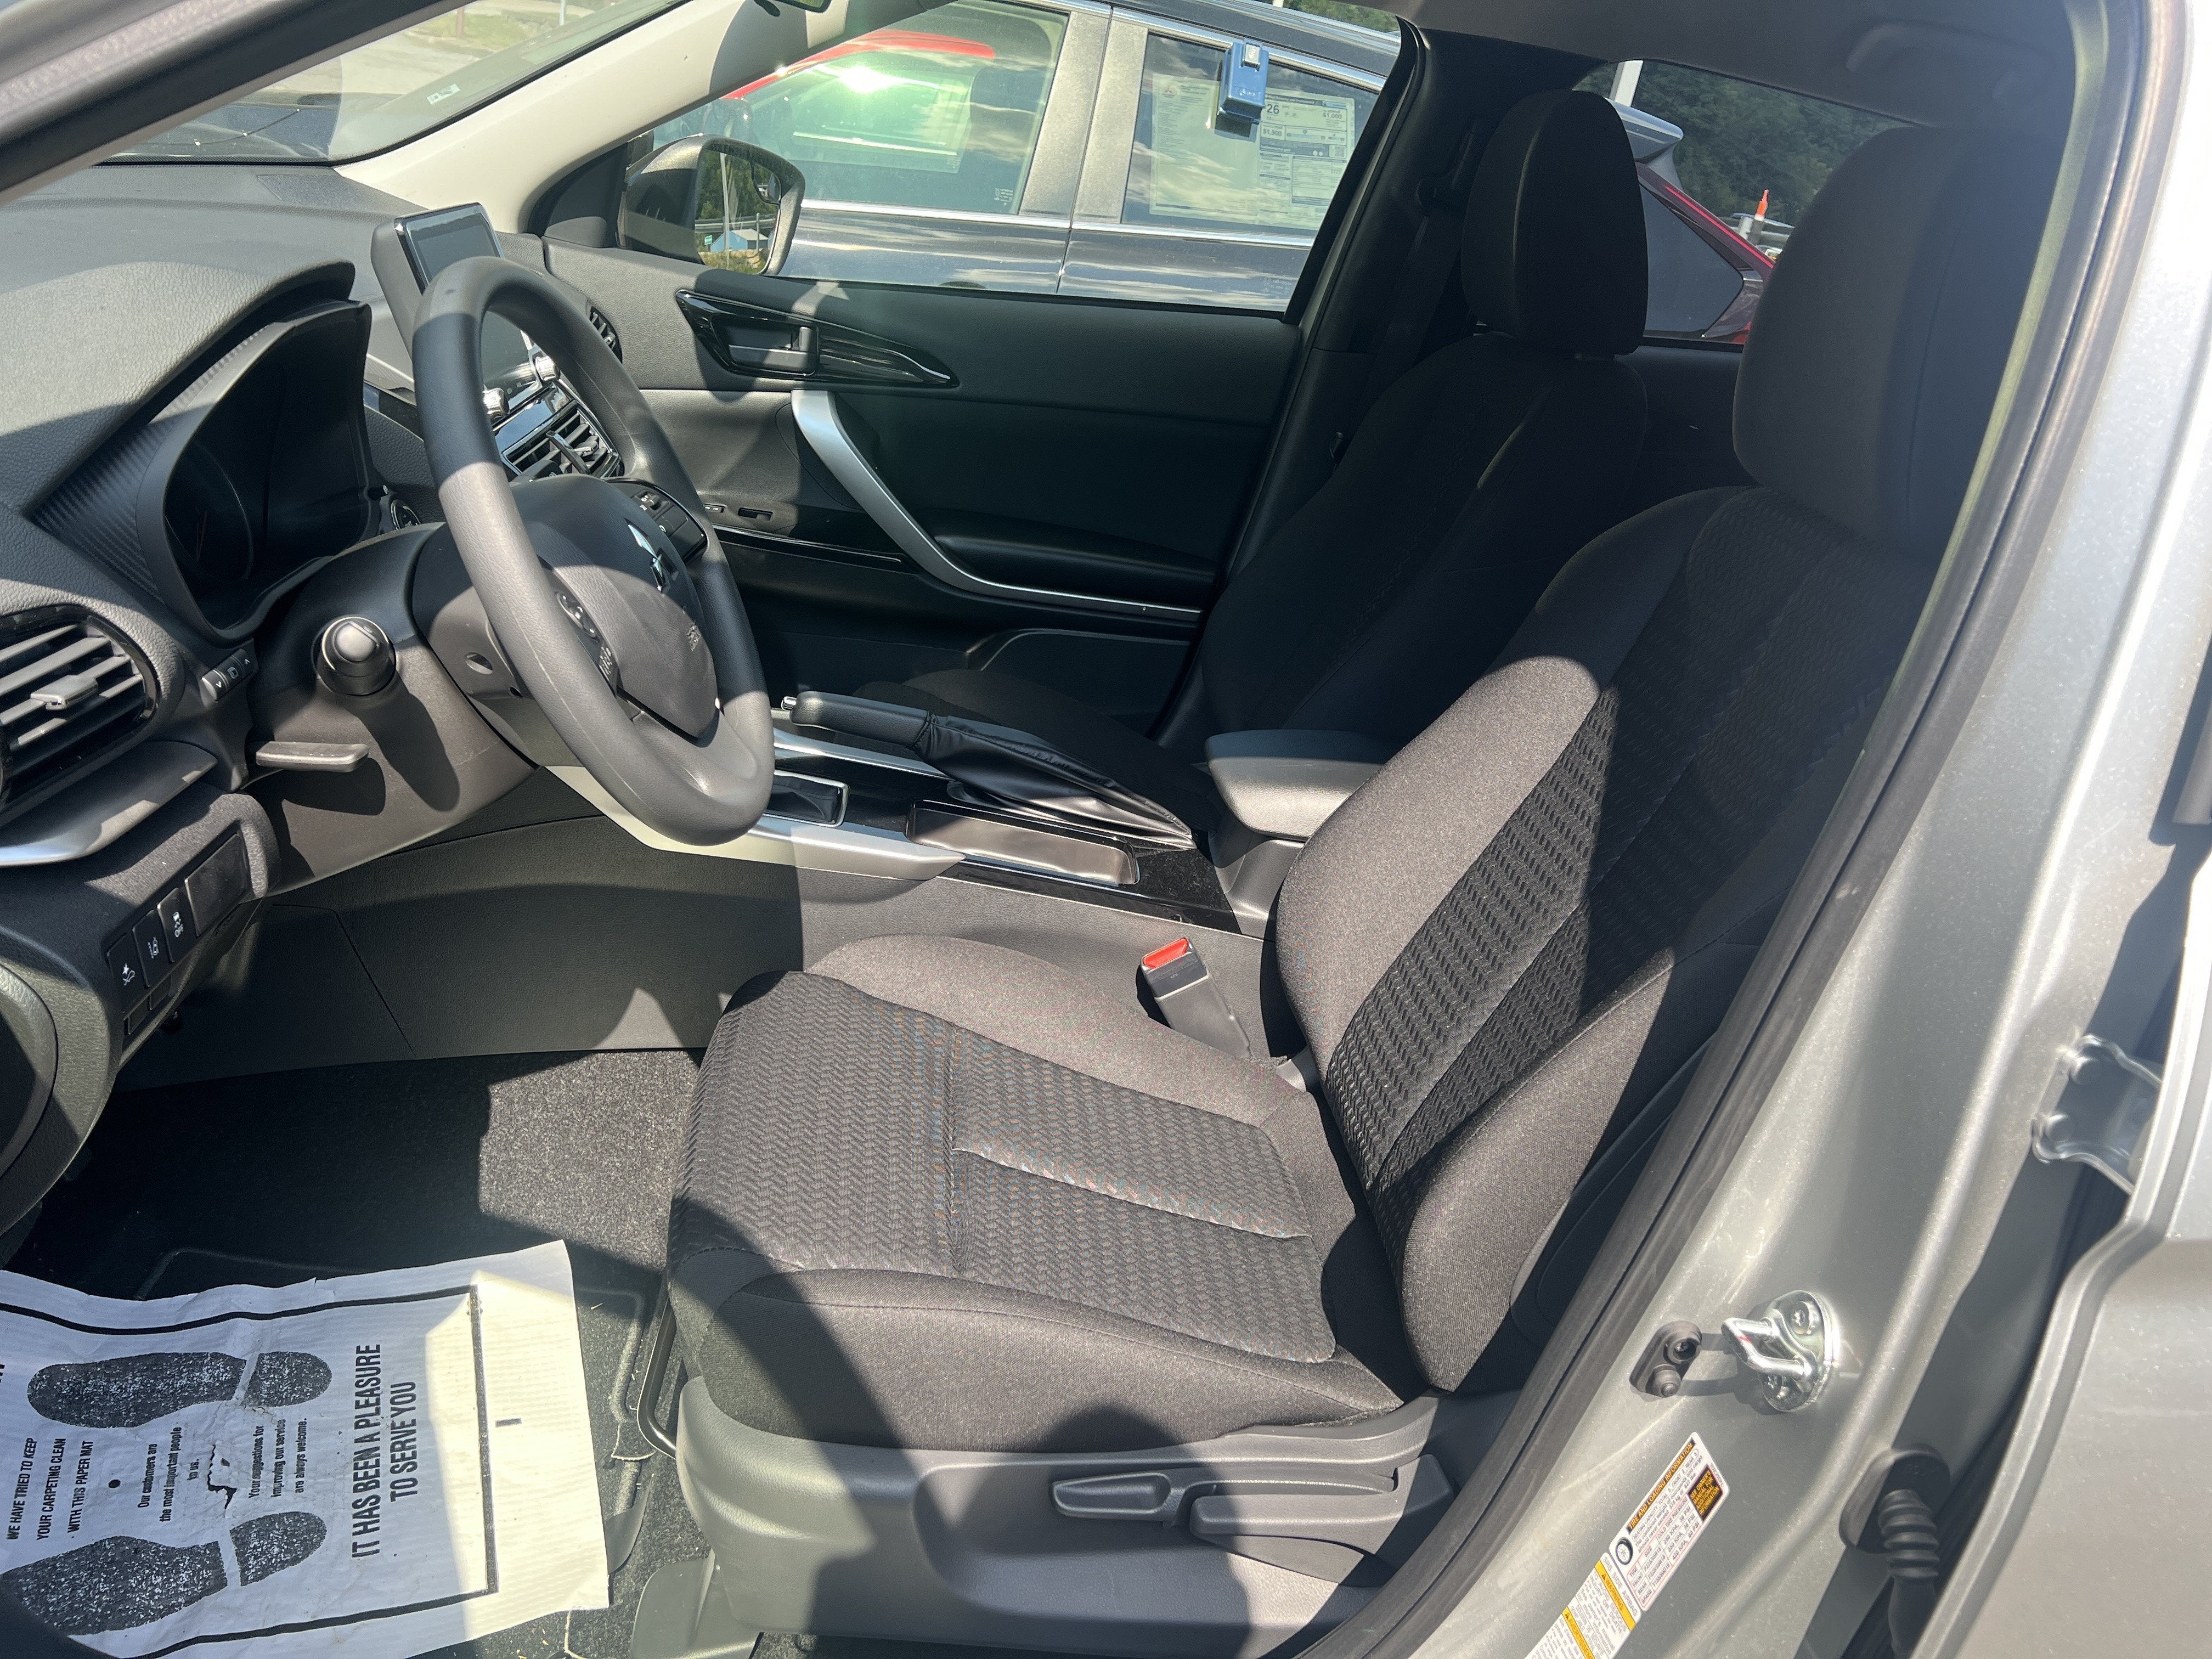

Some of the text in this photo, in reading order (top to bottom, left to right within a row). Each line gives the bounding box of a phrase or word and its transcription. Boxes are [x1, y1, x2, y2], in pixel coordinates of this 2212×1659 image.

[1267, 104, 1279, 115] 26
[253, 1425, 264, 1437] for
[389, 1381, 418, 1502] TO SERVE YOU
[187, 1459, 199, 1481] to us.
[275, 1447, 284, 1459] our
[294, 1418, 307, 1493] are always welcome.
[352, 1344, 381, 1558] IT HAS BEEN A PLEASURE
[6, 1438, 37, 1539] WE HAVE TRIED TO KEEP
[36, 1438, 66, 1541] YOUR CARPETING CLEAN
[67, 1440, 93, 1533] WITH THIS PAPER MAT
[142, 1455, 156, 1493] customers
[159, 1426, 182, 1522] the most important people
[248, 1480, 260, 1498] Your
[1628, 1441, 1693, 1530] TIRE AND LOADING INFORMATION
[137, 1495, 150, 1508] Our
[1644, 1544, 1652, 1558] SIZE
[1602, 1555, 1638, 1617] SRS SIDE AIRBAG
[1604, 1578, 1624, 1611] WARNING
[1632, 1571, 1644, 1588] FRONT
